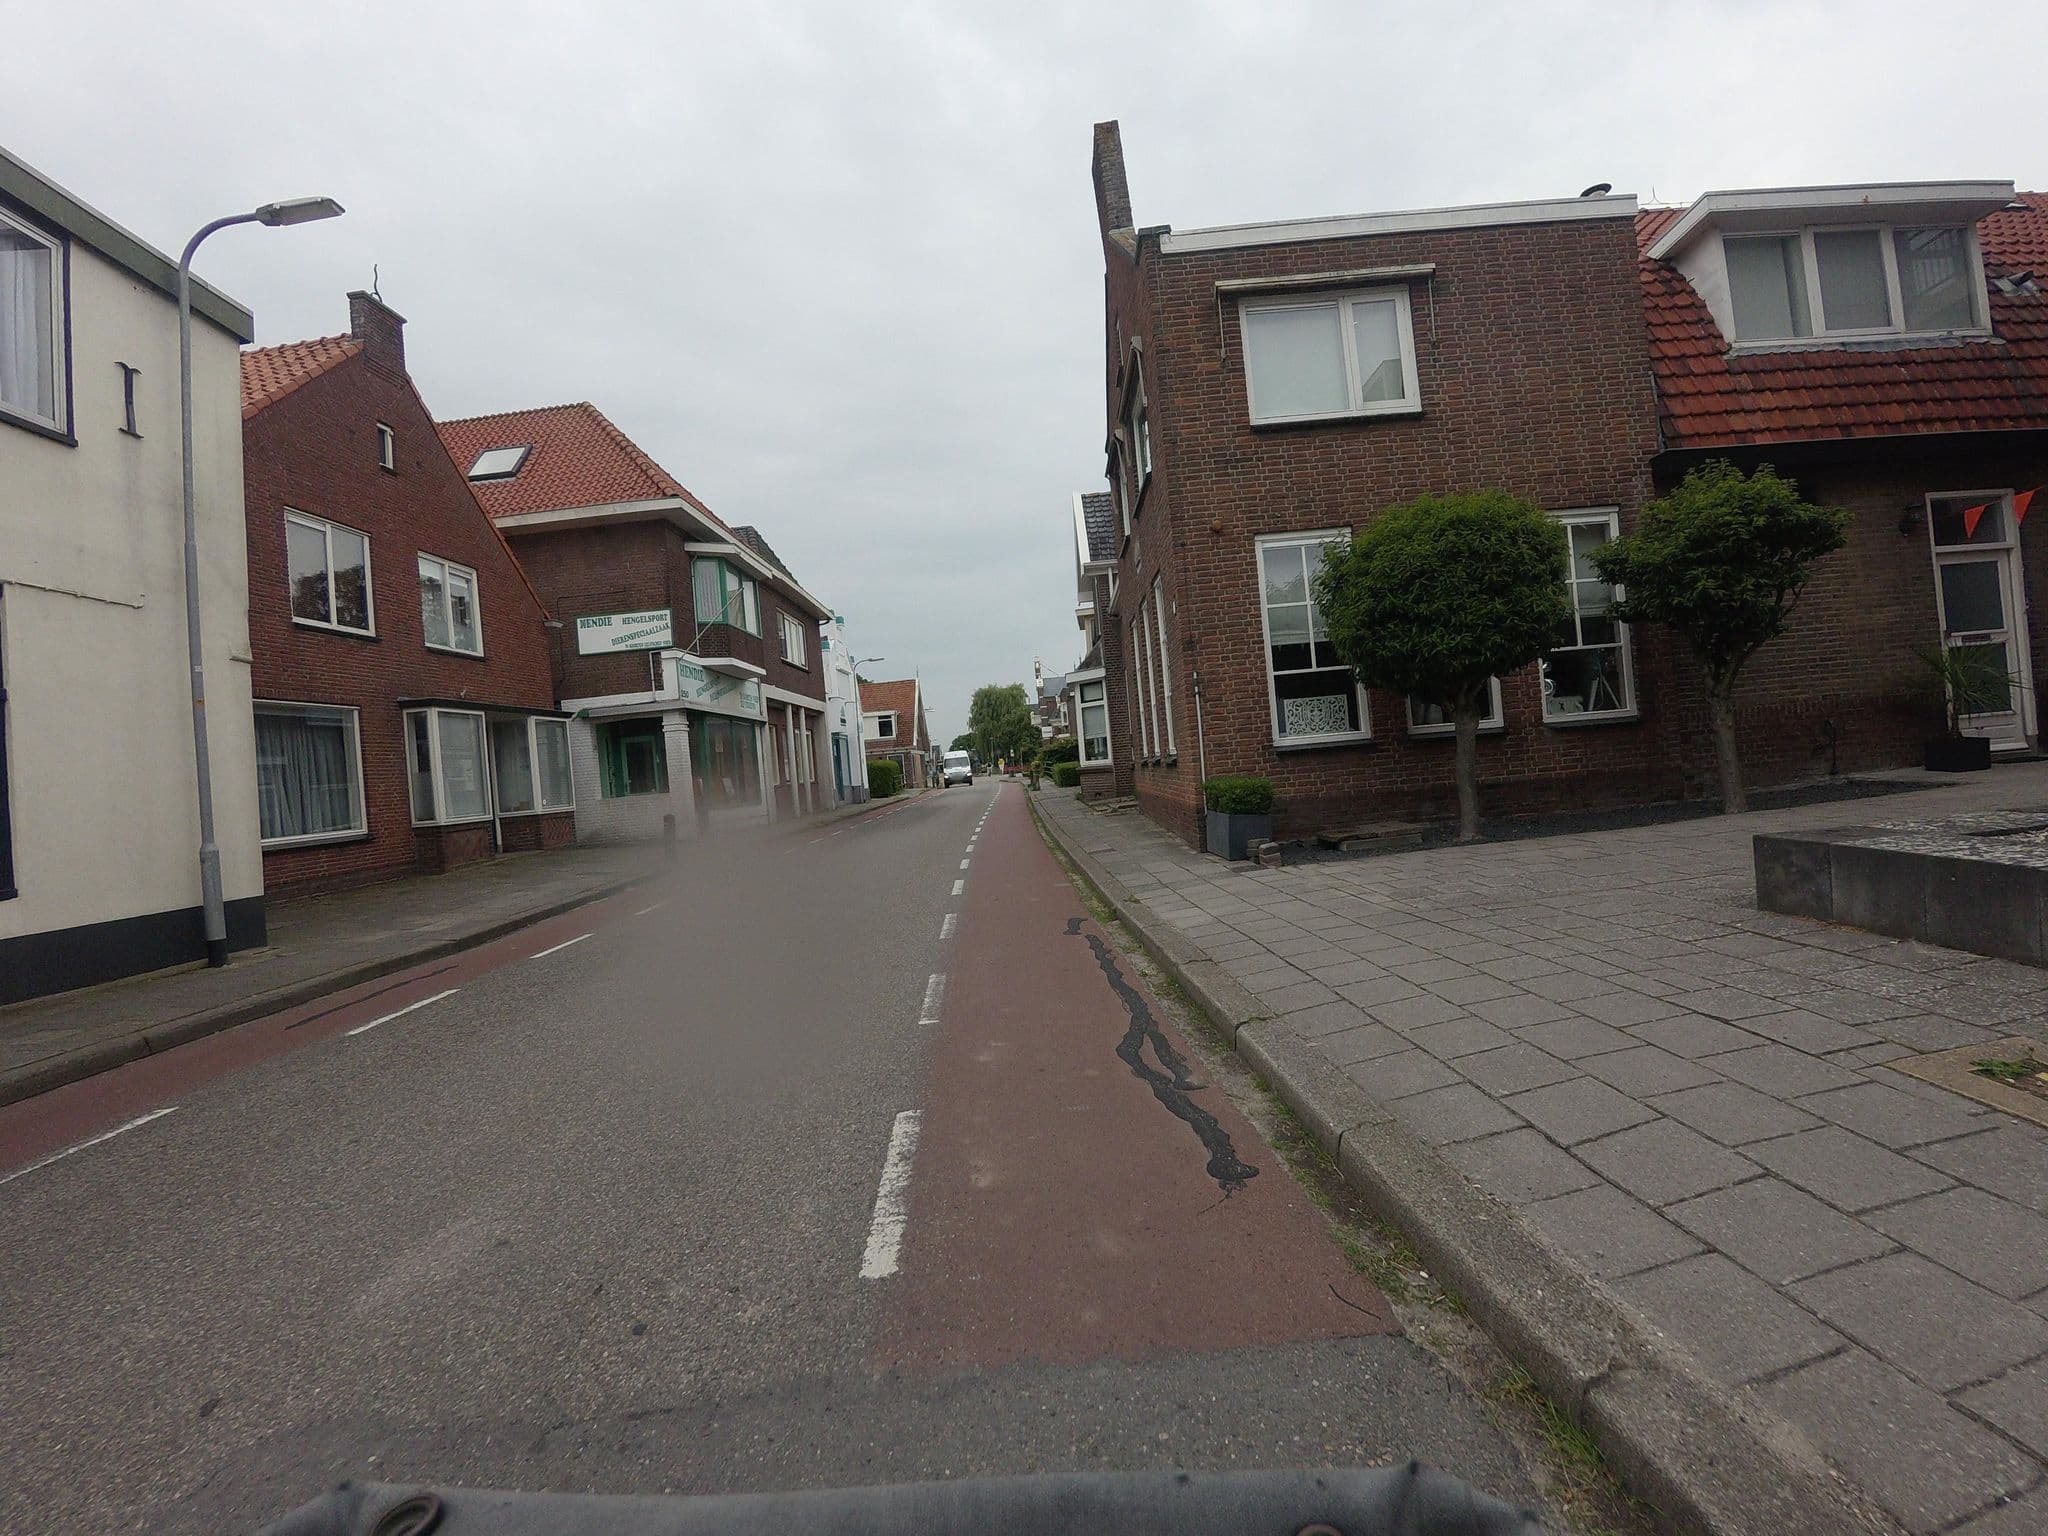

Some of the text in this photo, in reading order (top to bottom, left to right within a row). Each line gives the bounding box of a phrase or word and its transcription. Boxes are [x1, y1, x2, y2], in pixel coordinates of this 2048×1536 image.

[622, 613, 668, 626] HENGELSPORT
[611, 622, 671, 646] DIERENSPECIAALZAAK
[679, 663, 705, 683] HENDIE
